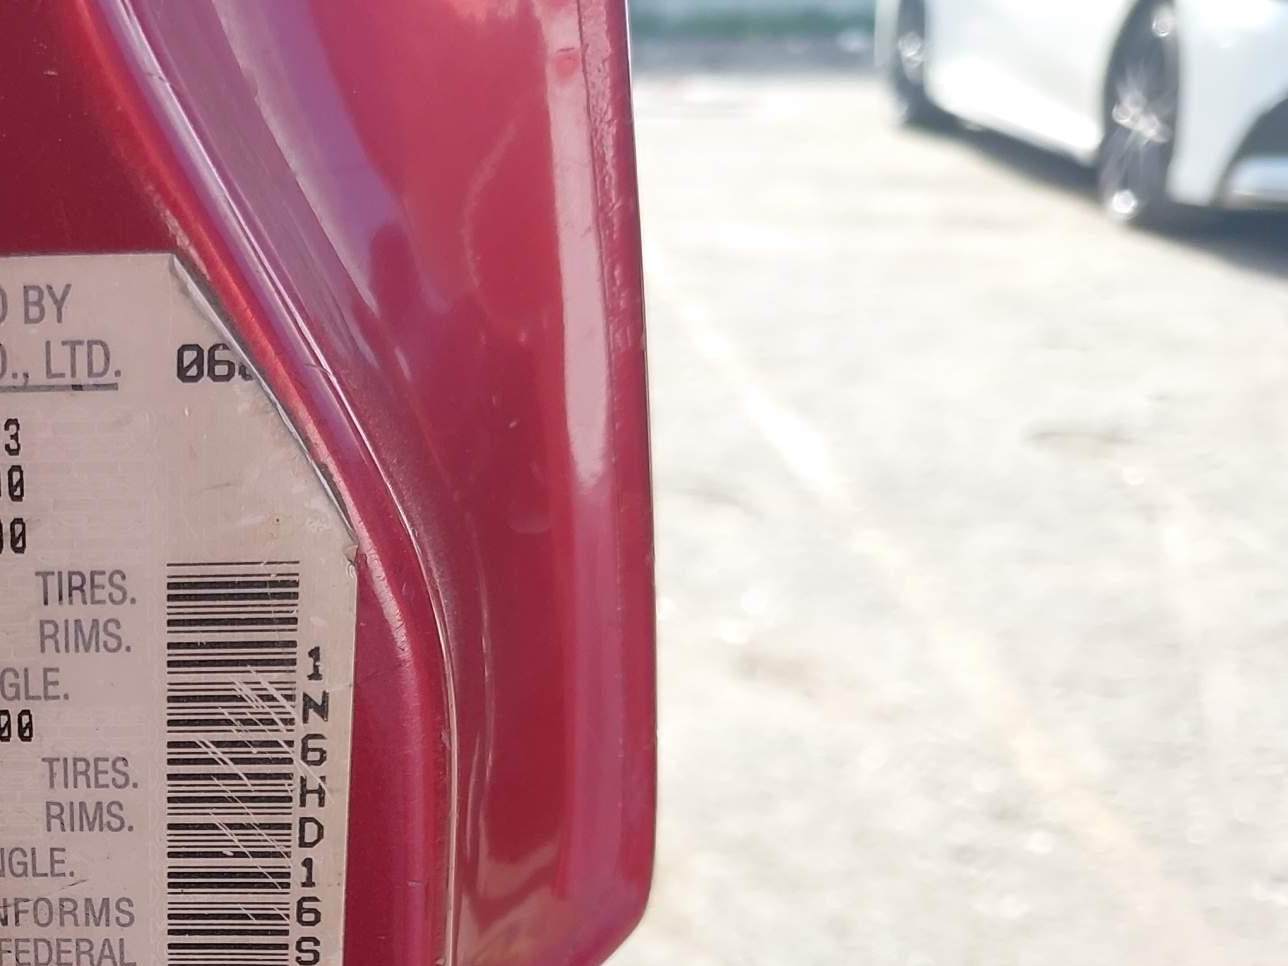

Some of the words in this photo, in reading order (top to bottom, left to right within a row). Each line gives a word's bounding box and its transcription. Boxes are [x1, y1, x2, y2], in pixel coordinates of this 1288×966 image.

[21, 285, 72, 324] BY
[44, 340, 122, 380] LTD.
[35, 571, 136, 607] TIRES.
[39, 619, 132, 655] RIMS.
[41, 757, 139, 790] TIRES.
[44, 801, 134, 833] RIMS.
